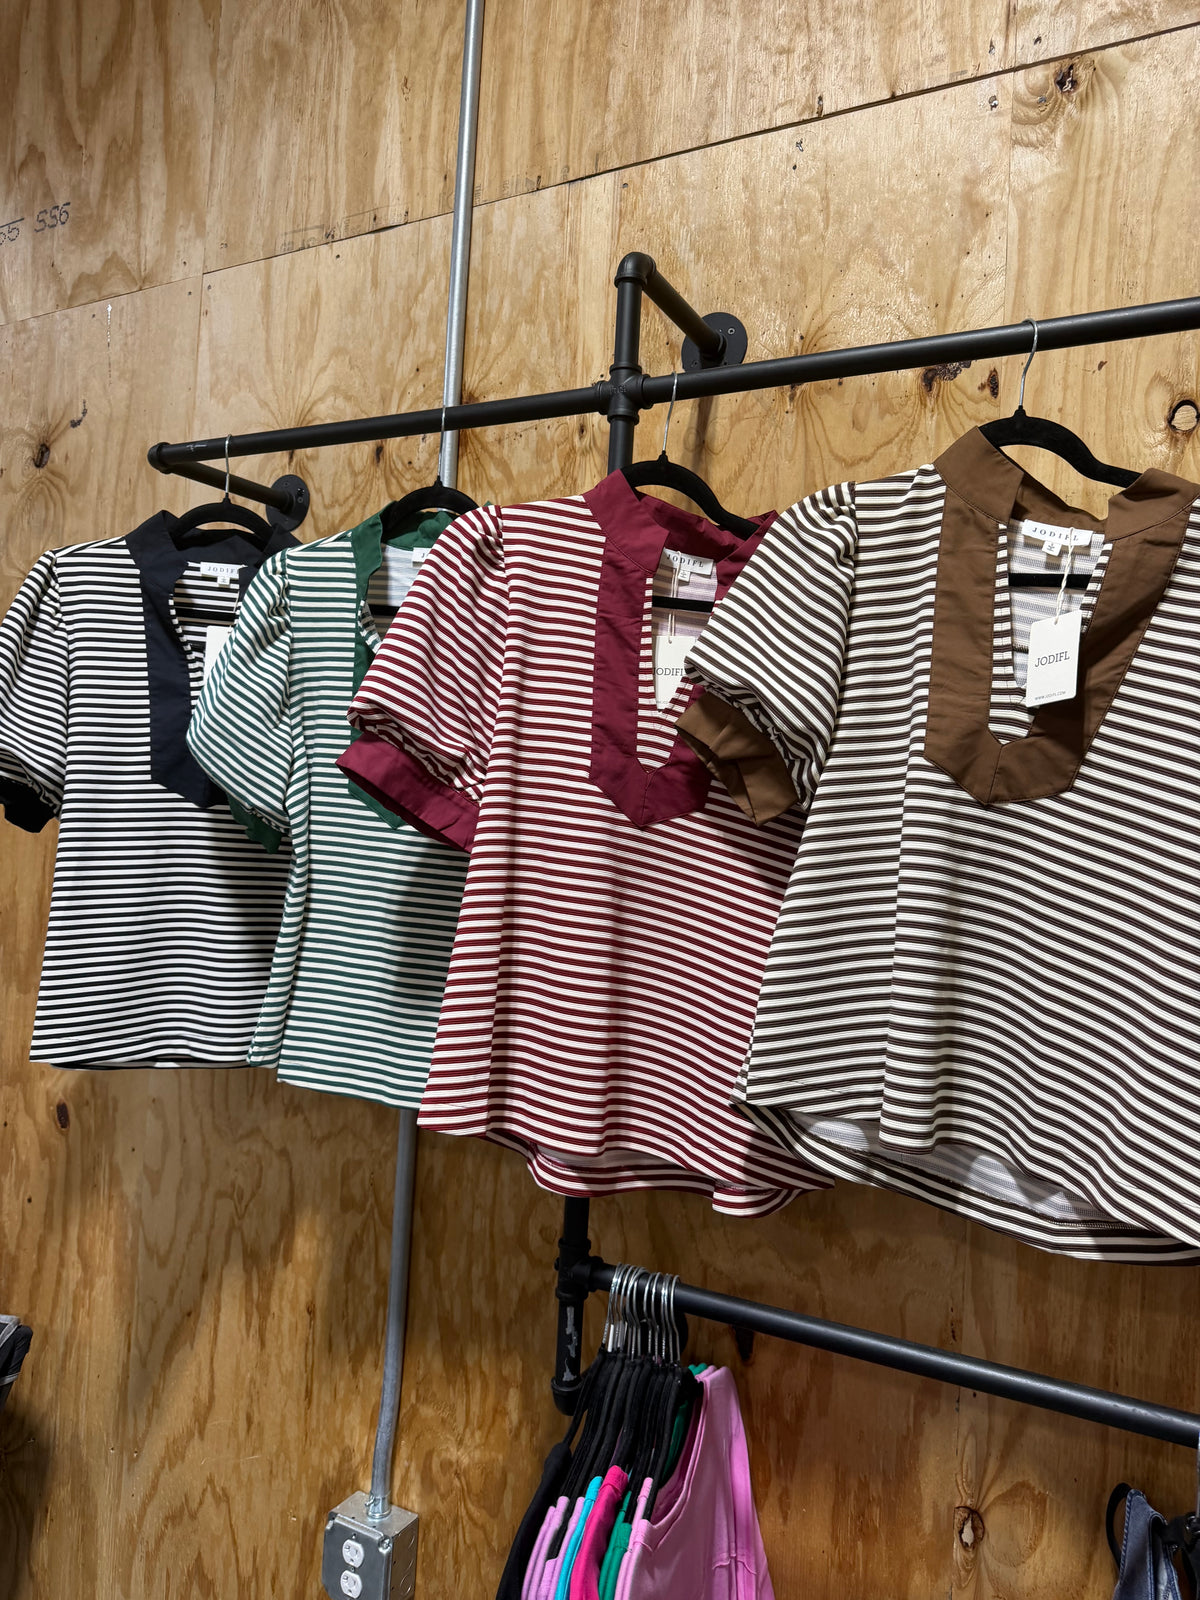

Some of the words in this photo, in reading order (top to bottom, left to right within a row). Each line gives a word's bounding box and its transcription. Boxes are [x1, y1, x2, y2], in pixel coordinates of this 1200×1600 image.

[666, 554, 704, 568] JODIFL
[207, 566, 239, 574] JODIF
[1034, 651, 1071, 668] JODIFL
